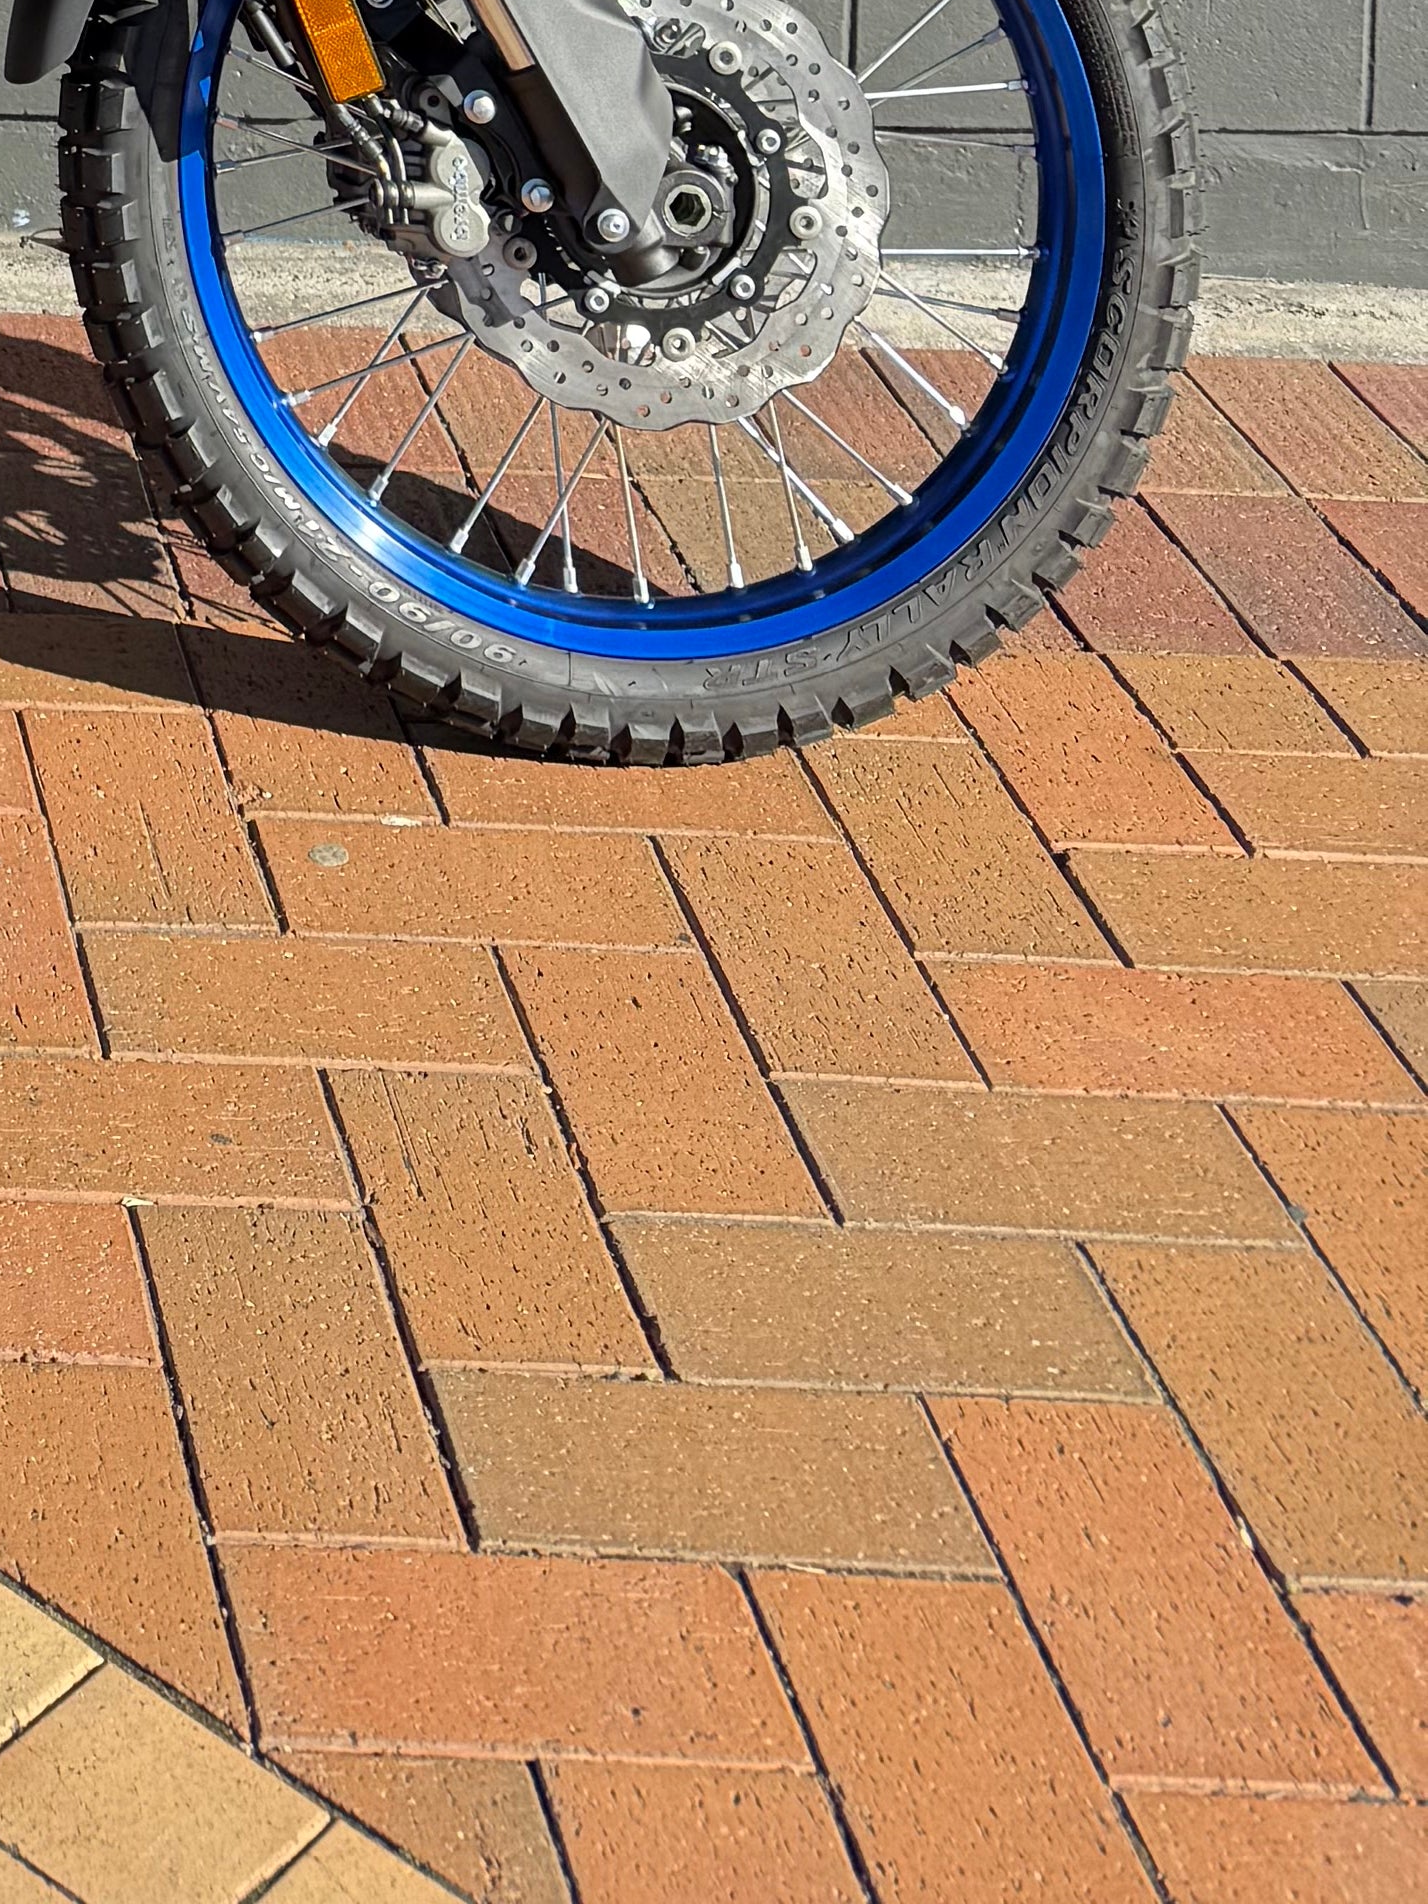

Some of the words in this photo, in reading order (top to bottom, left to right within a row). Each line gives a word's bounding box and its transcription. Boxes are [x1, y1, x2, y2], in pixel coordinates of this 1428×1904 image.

[447, 156, 470, 241] brembo
[208, 379, 252, 448] 54V
[988, 249, 1140, 547] SCORPION
[247, 448, 302, 515] M/C
[282, 505, 520, 667] 90/90-21
[834, 538, 1001, 659] RALLY
[702, 645, 820, 693] STR
